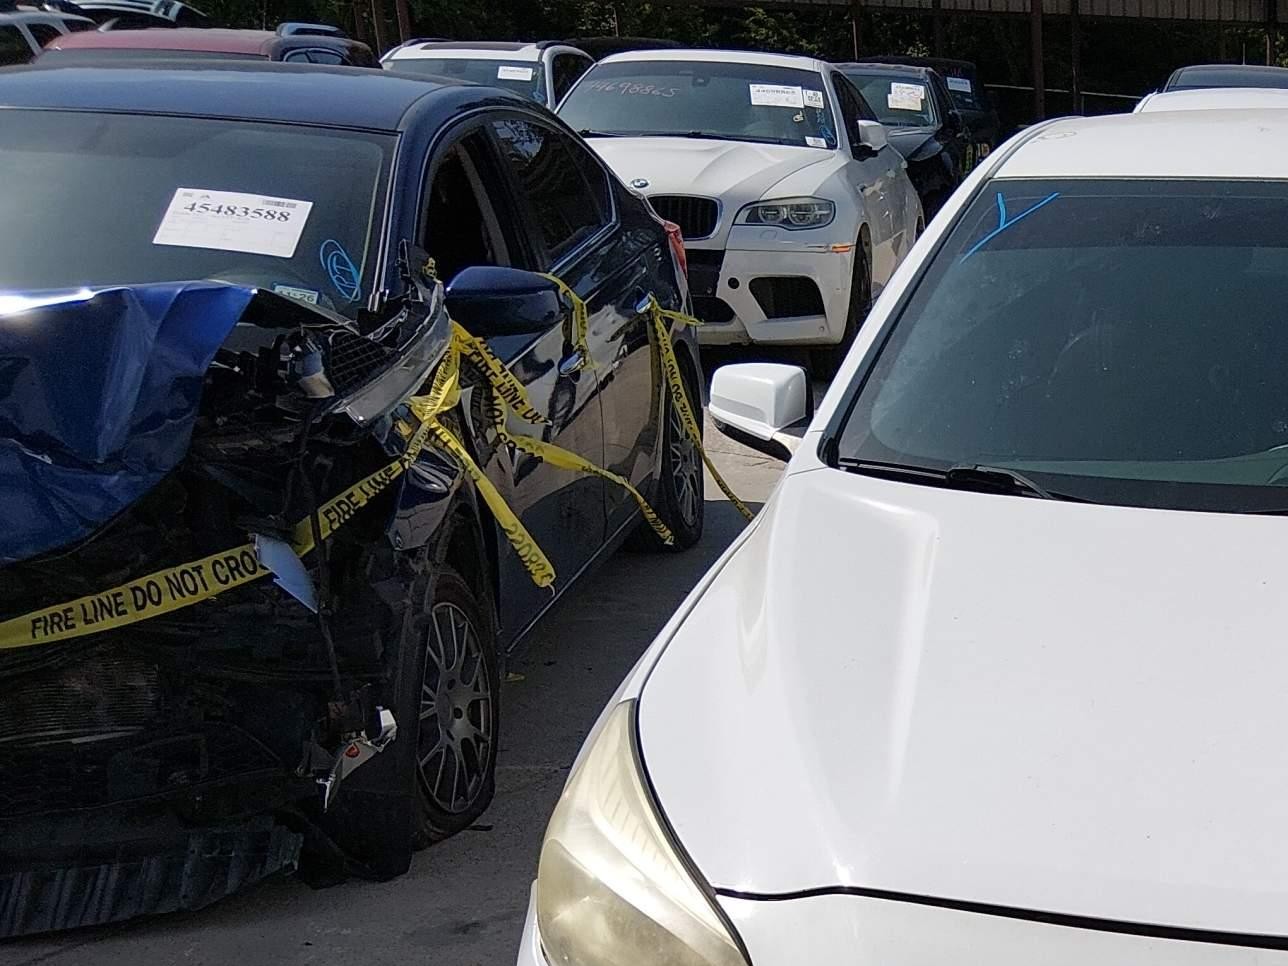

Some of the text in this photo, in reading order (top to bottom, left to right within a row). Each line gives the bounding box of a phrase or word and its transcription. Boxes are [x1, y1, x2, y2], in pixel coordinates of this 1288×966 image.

[184, 201, 291, 223] 45483588
[31, 607, 76, 639] FIRE
[81, 592, 128, 625] LINE
[131, 580, 162, 611] DO
[165, 565, 209, 598] NOT
